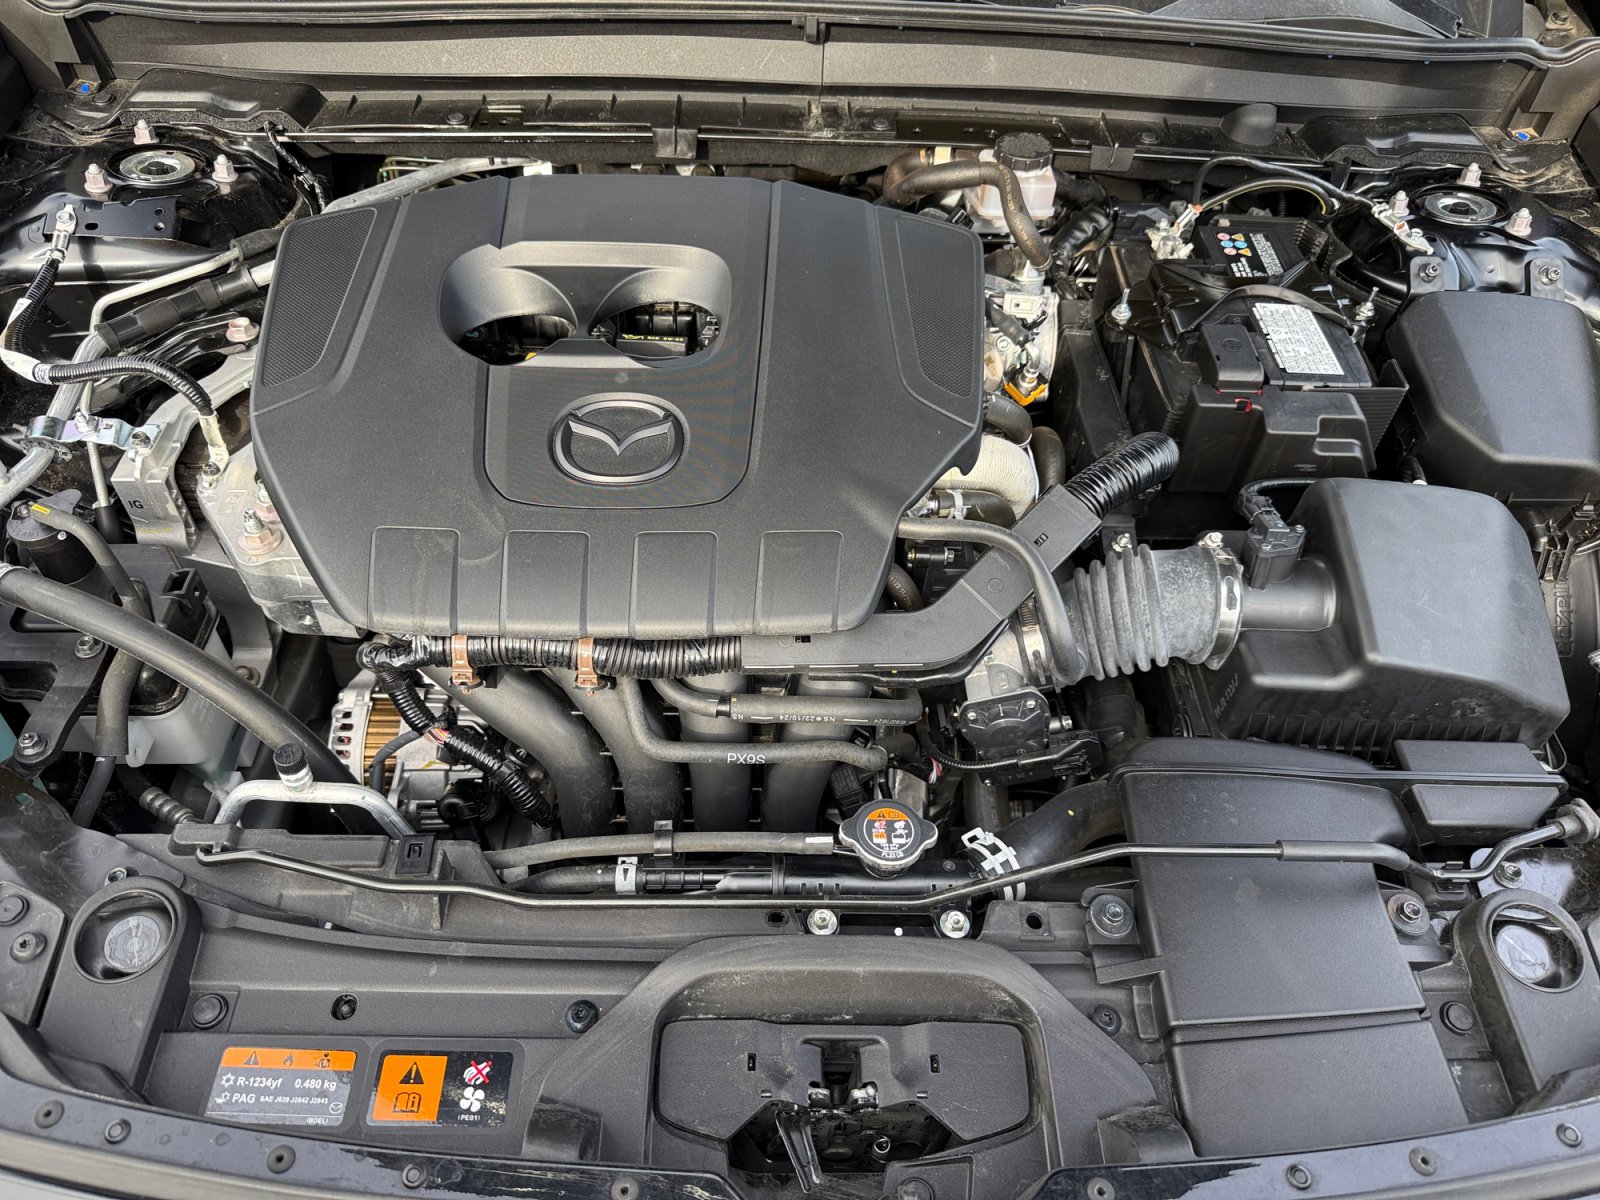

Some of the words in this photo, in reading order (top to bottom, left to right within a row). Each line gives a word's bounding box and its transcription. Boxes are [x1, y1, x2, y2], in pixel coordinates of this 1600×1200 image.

[128, 499, 144, 509] IG
[236, 1077, 283, 1089] R-1234yf
[294, 1078, 322, 1089] 0.480
[323, 1080, 337, 1091] kg
[231, 1093, 256, 1104] PAG
